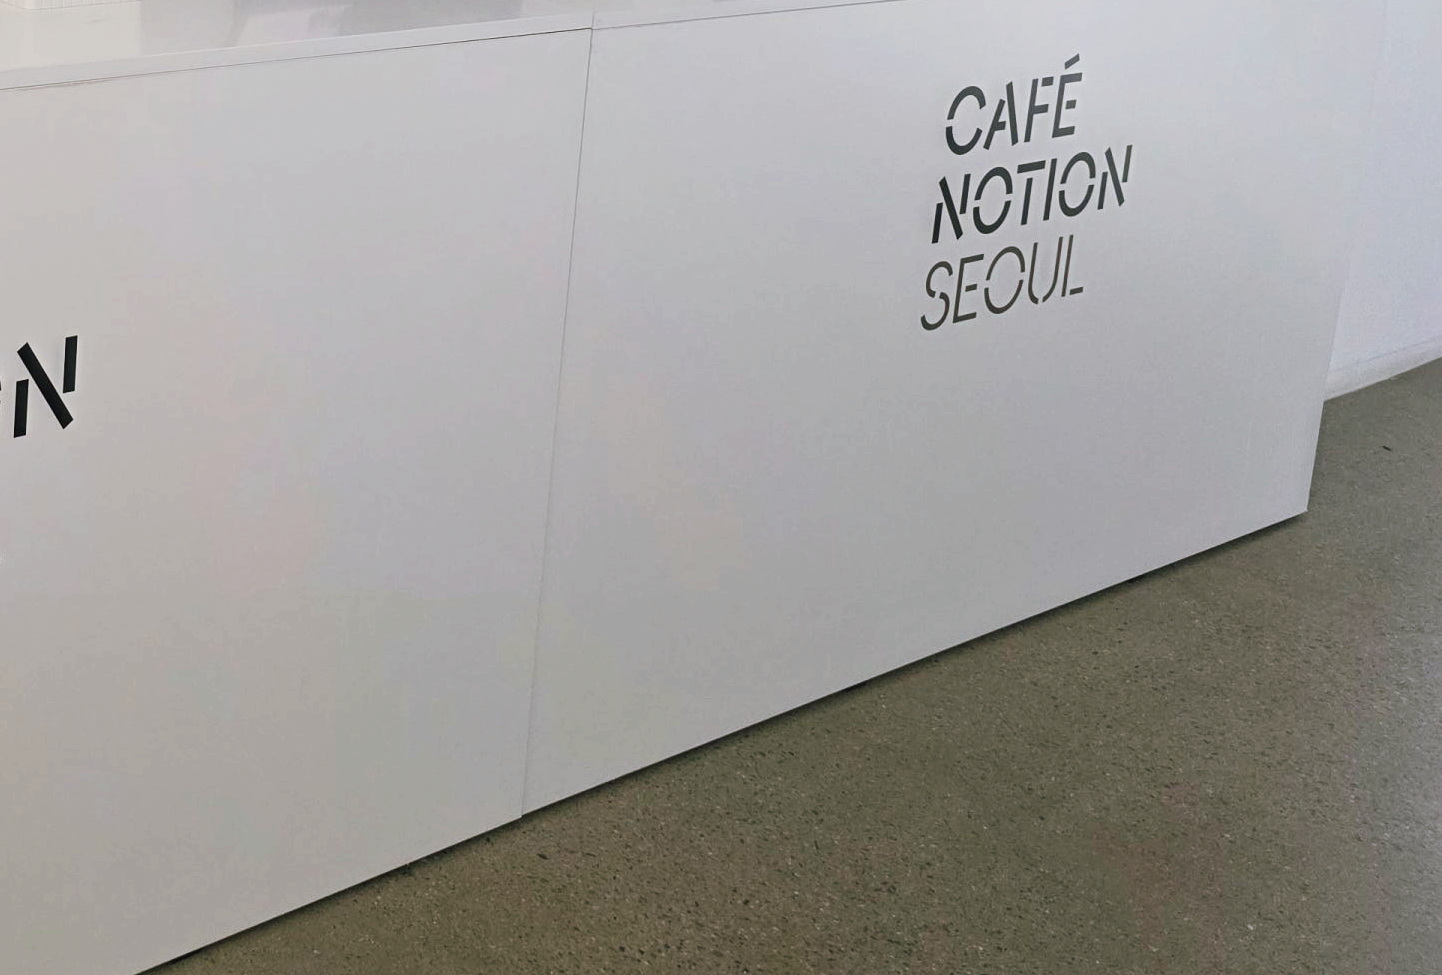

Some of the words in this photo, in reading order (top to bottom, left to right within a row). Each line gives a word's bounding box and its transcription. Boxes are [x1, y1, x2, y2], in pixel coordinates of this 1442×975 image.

[945, 53, 1083, 155] CAFÉ
[931, 144, 1133, 244] NOTION
[920, 234, 1084, 331] SEOUL
